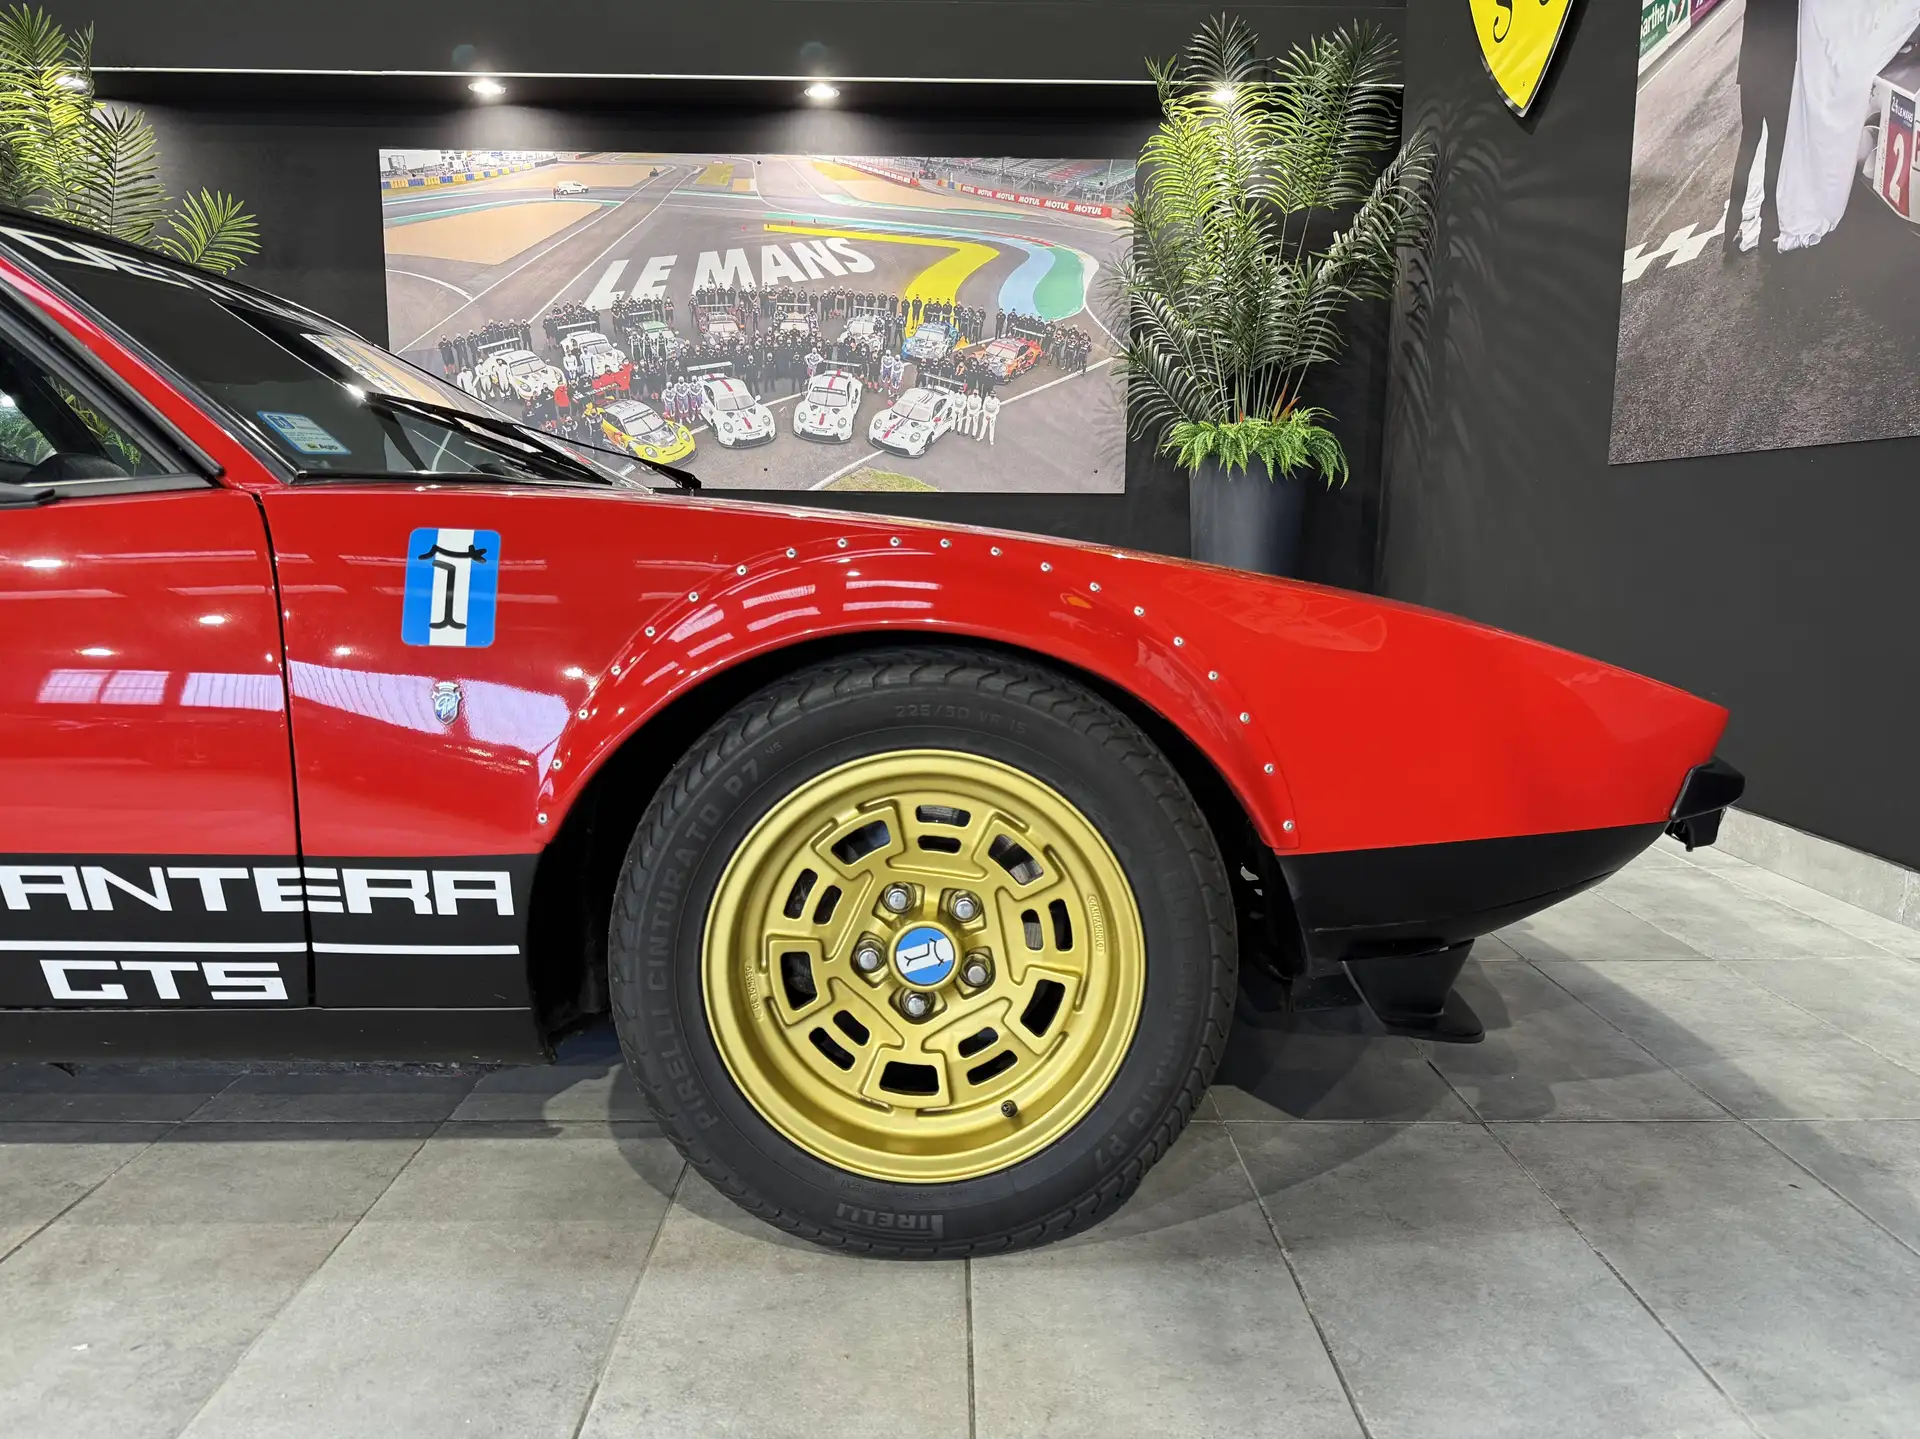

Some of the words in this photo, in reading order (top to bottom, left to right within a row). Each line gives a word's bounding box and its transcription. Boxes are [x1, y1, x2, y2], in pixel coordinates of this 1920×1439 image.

[996, 191, 1015, 201] MOTUL
[1018, 196, 1040, 206] MOTUL
[1044, 200, 1070, 211] MOTUL
[1074, 204, 1102, 215] MOTUL
[584, 255, 678, 311] LE
[692, 237, 876, 299] MANS
[723, 758, 759, 797] P7
[0, 865, 515, 916] ANTERA
[648, 803, 722, 991] CINTURATO
[40, 959, 288, 1000] GTS
[653, 1008, 719, 1130] PIRELLI
[1094, 1132, 1128, 1170] P7
[833, 1202, 944, 1239] PIRELLI
